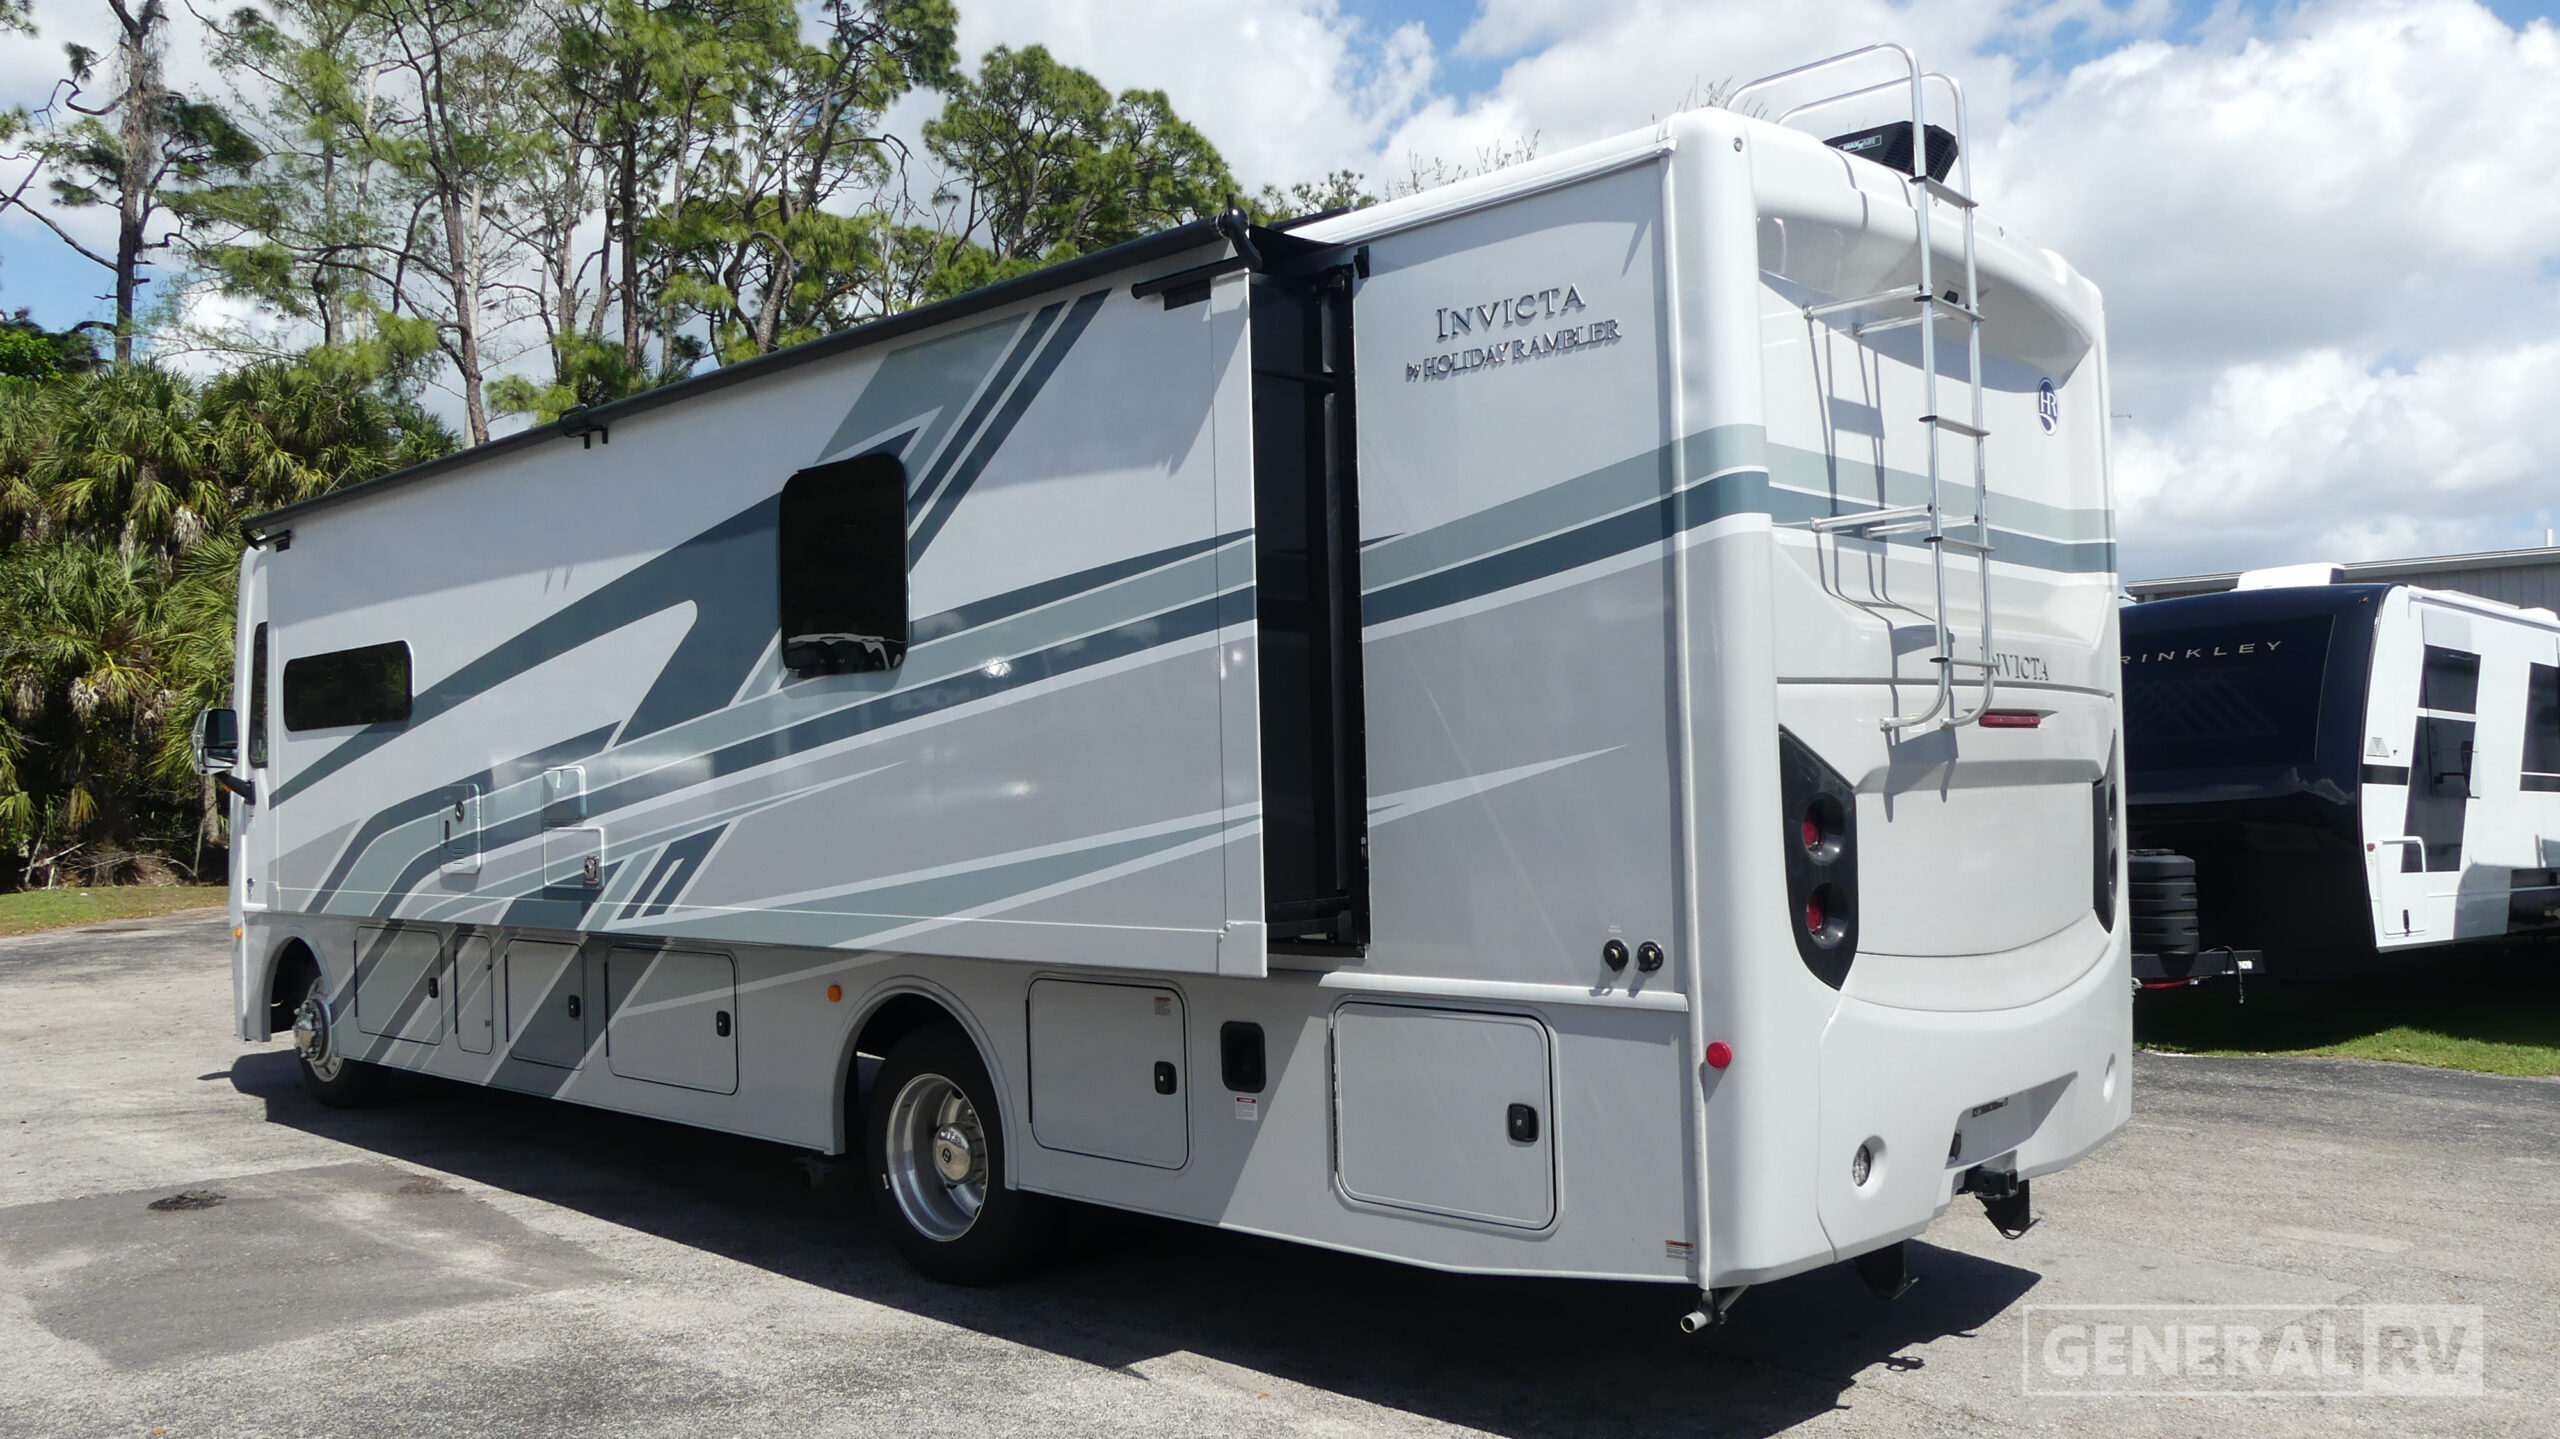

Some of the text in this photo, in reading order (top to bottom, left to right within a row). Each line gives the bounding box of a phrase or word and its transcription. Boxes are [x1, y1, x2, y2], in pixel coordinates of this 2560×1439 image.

[1436, 283, 1587, 338] INVICTA
[1406, 319, 1622, 378] by HOLIDAY RAMBLER
[1979, 646, 2050, 681] NVICTA
[2120, 640, 2282, 664] RINKLEY
